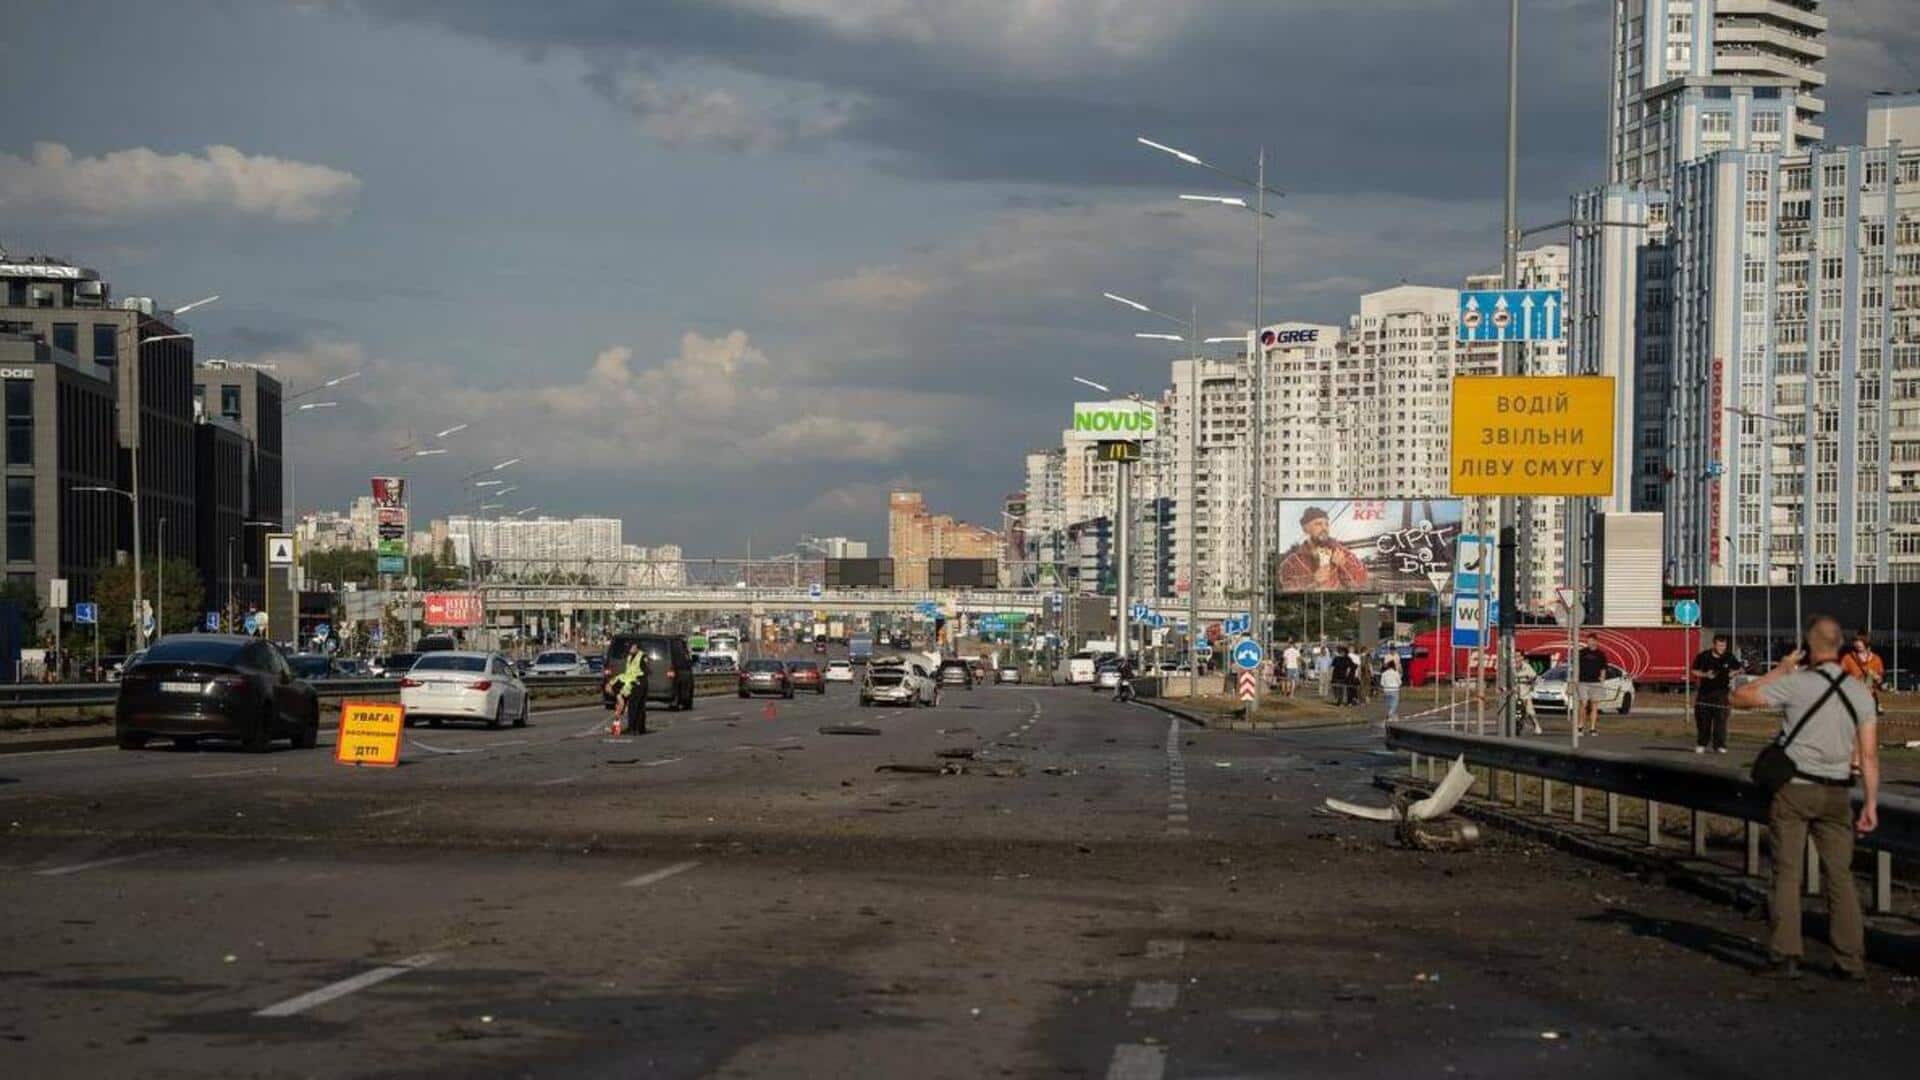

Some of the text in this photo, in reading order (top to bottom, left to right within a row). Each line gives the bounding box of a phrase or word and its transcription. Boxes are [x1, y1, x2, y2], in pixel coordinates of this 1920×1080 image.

[1277, 329, 1319, 343] GREE
[1497, 392, 1569, 414] ВОДІЙ
[1075, 411, 1154, 432] NOVUS
[1481, 427, 1584, 445] ЗВІЛЬНИ
[1459, 459, 1604, 477] ЛІВУ СМУГУ
[1352, 510, 1385, 520] KFC
[352, 712, 395, 722] УВАГА!
[355, 745, 380, 756] ДТП
